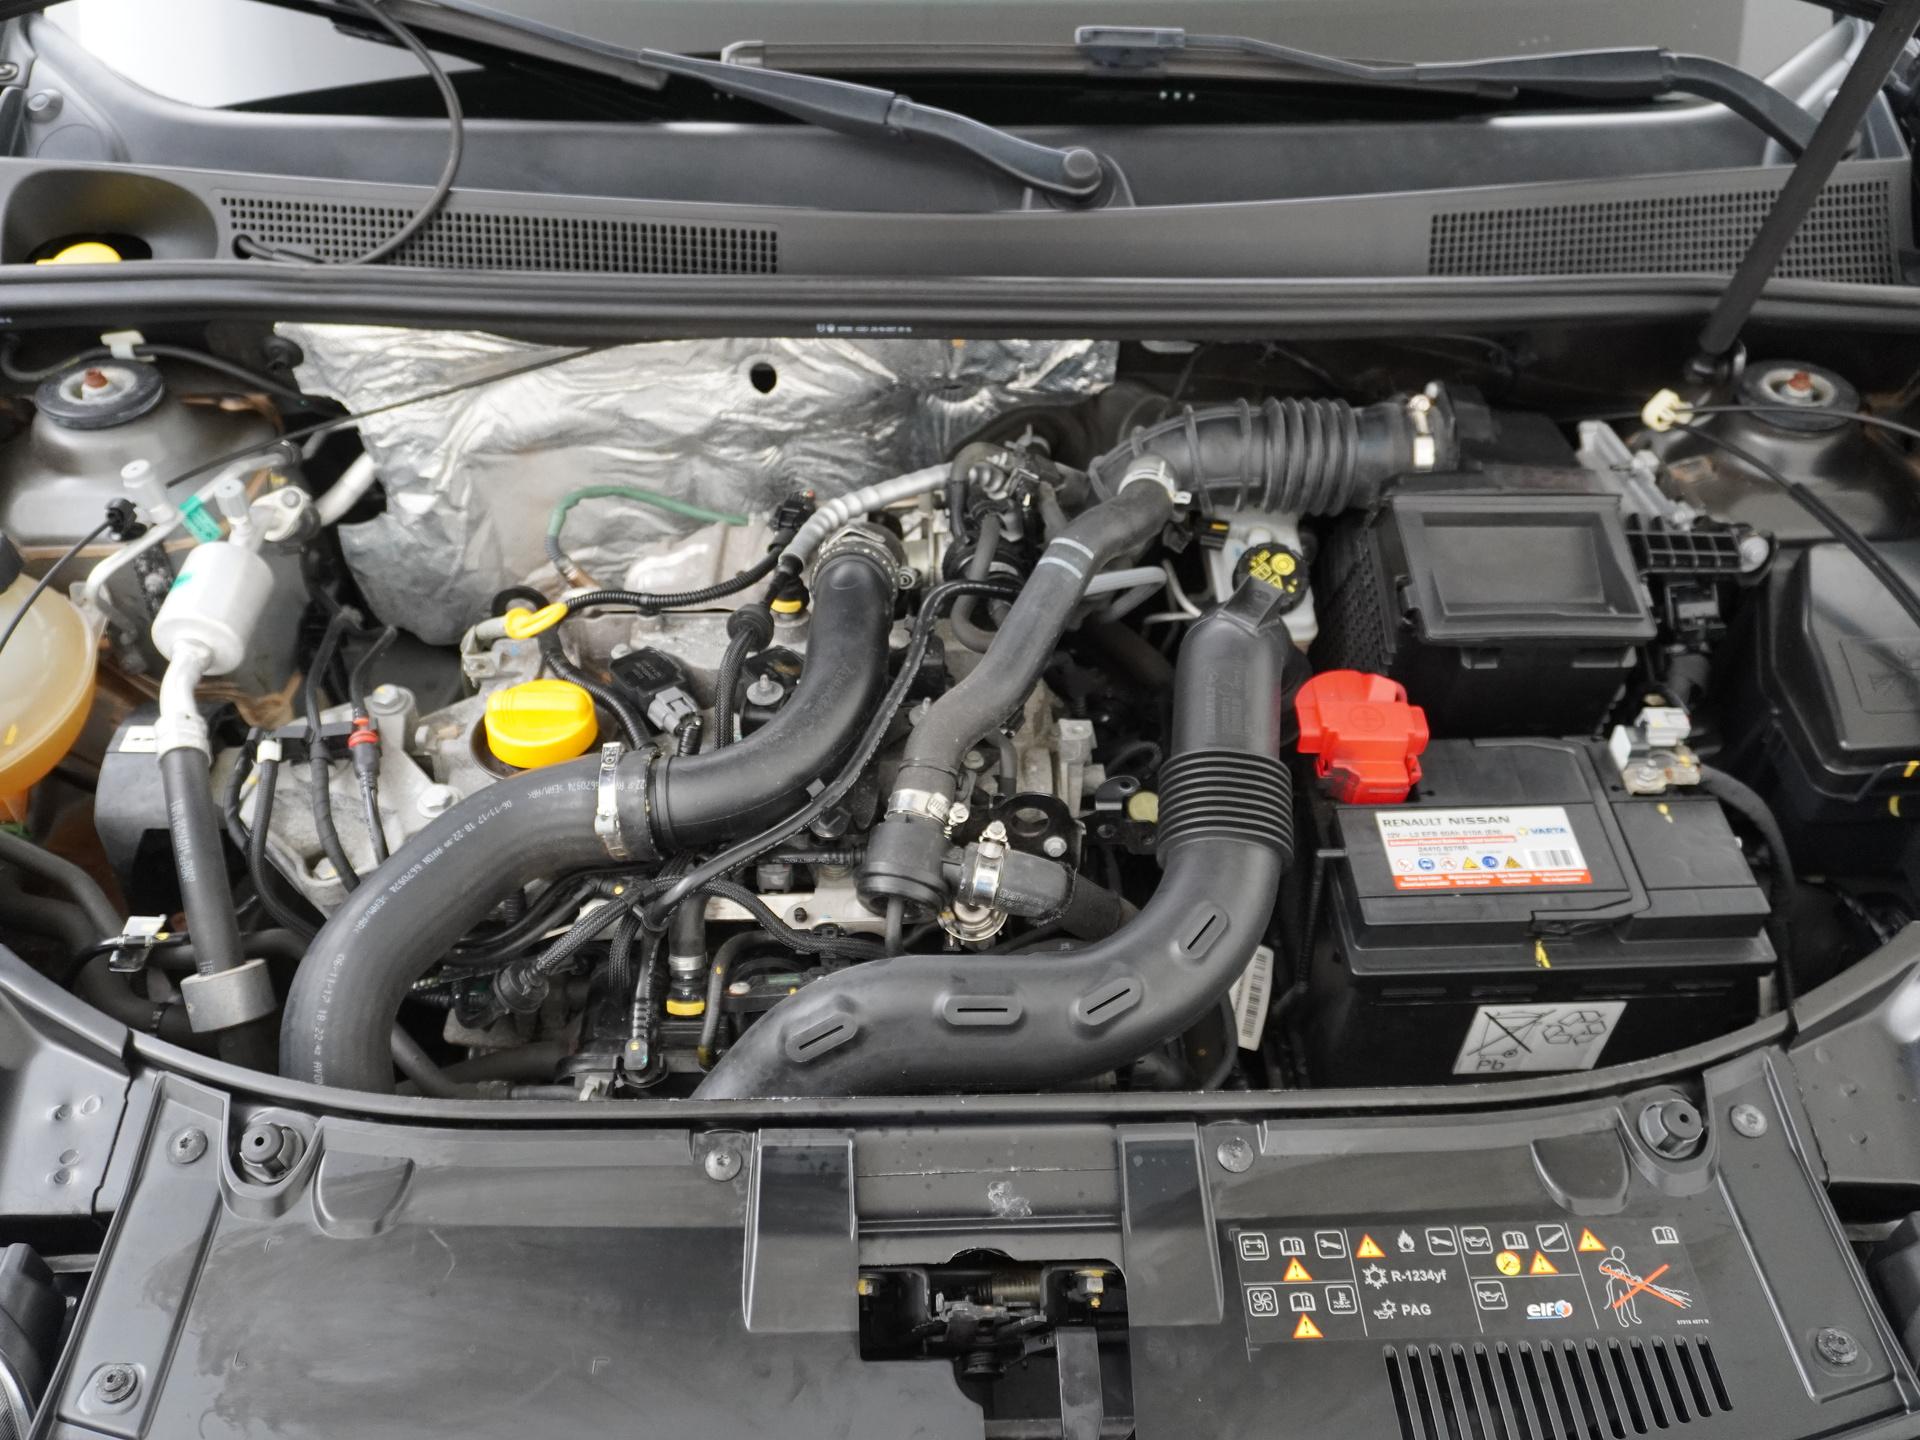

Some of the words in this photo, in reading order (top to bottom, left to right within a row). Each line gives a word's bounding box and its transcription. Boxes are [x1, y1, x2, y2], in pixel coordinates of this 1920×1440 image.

[1382, 816, 1443, 828] RENAULT
[1448, 814, 1511, 826] NISSAN
[1529, 826, 1568, 835] VARTA
[1476, 1059, 1505, 1071] Pb
[1390, 1268, 1447, 1284] R-1234yf
[1400, 1302, 1432, 1317] PAG
[1526, 1302, 1556, 1317] elf
